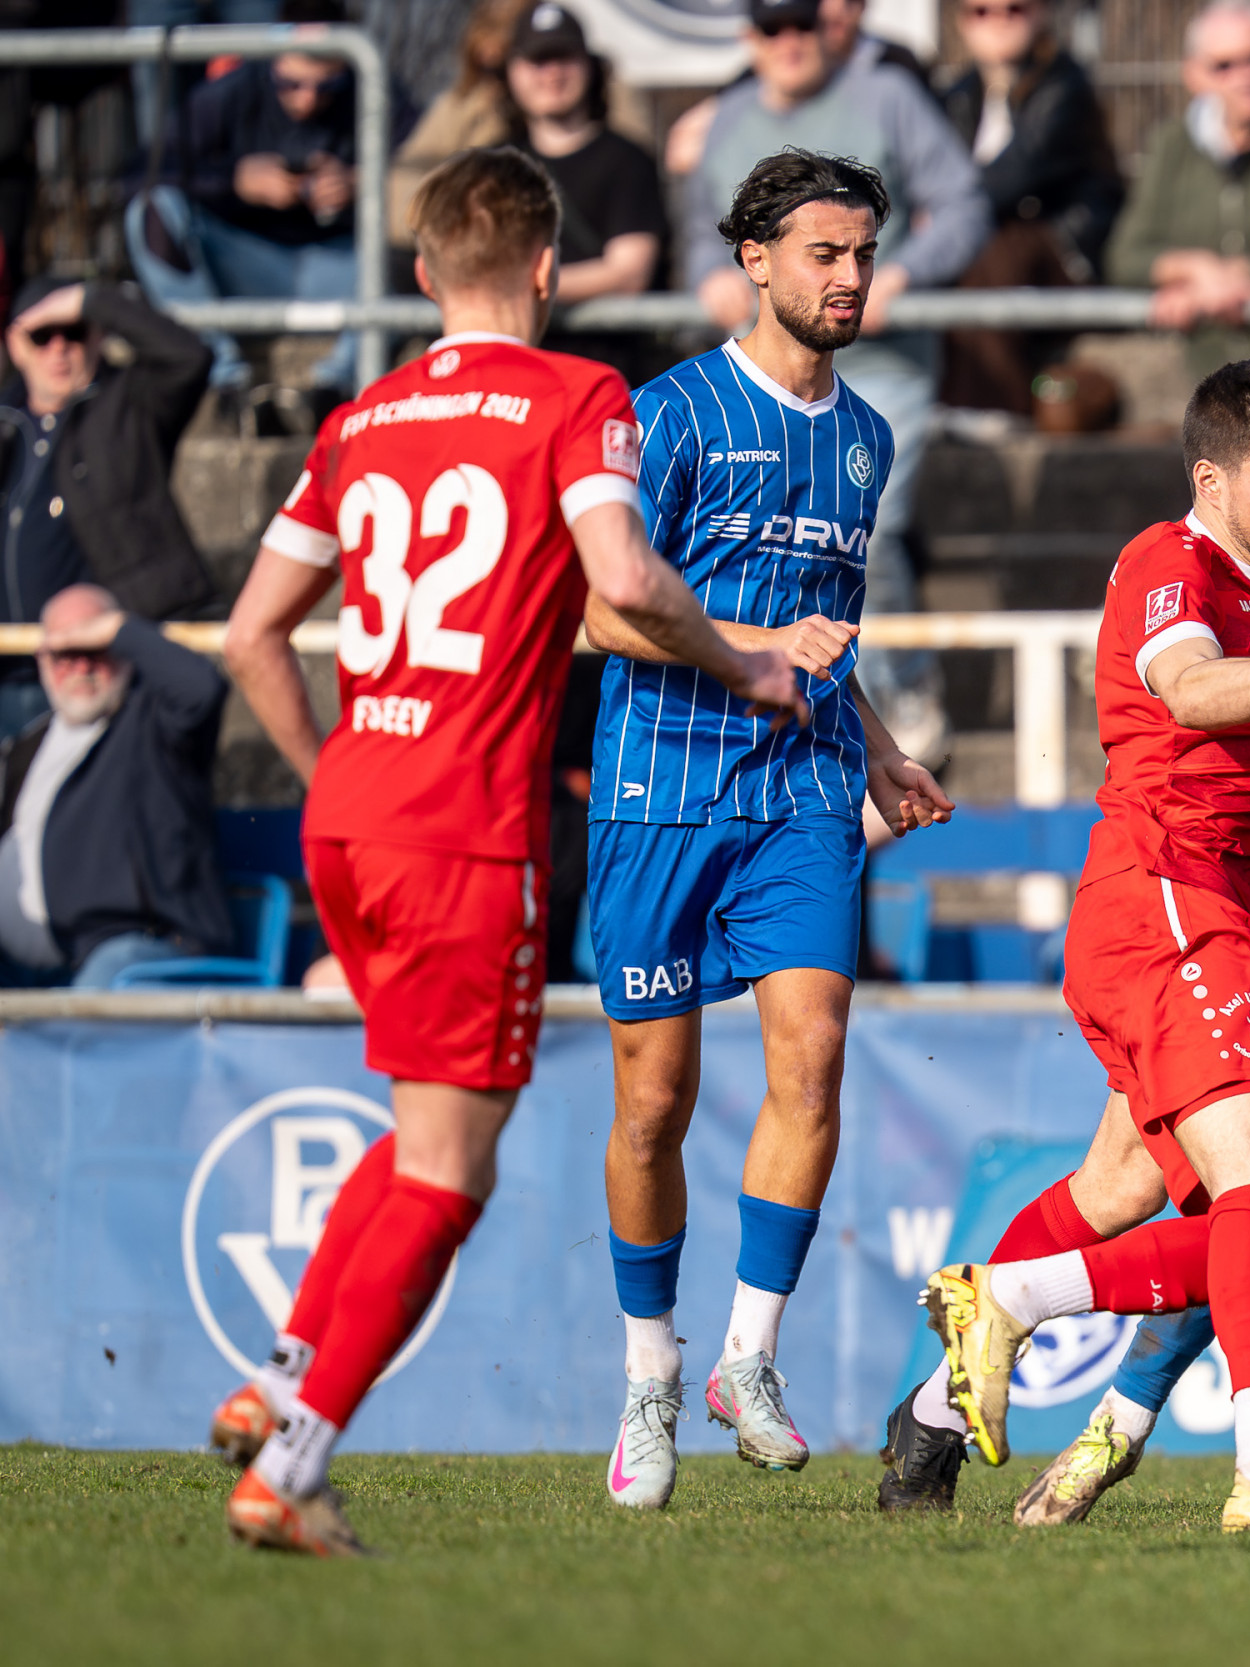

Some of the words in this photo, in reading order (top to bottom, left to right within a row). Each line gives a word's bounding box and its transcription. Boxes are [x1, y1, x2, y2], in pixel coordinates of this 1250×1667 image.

[727, 450, 781, 464] PATRICK
[338, 463, 508, 680] 32
[622, 958, 694, 1000] BAB
[1219, 992, 1245, 1017] Axel
[1150, 1279, 1164, 1313] JA
